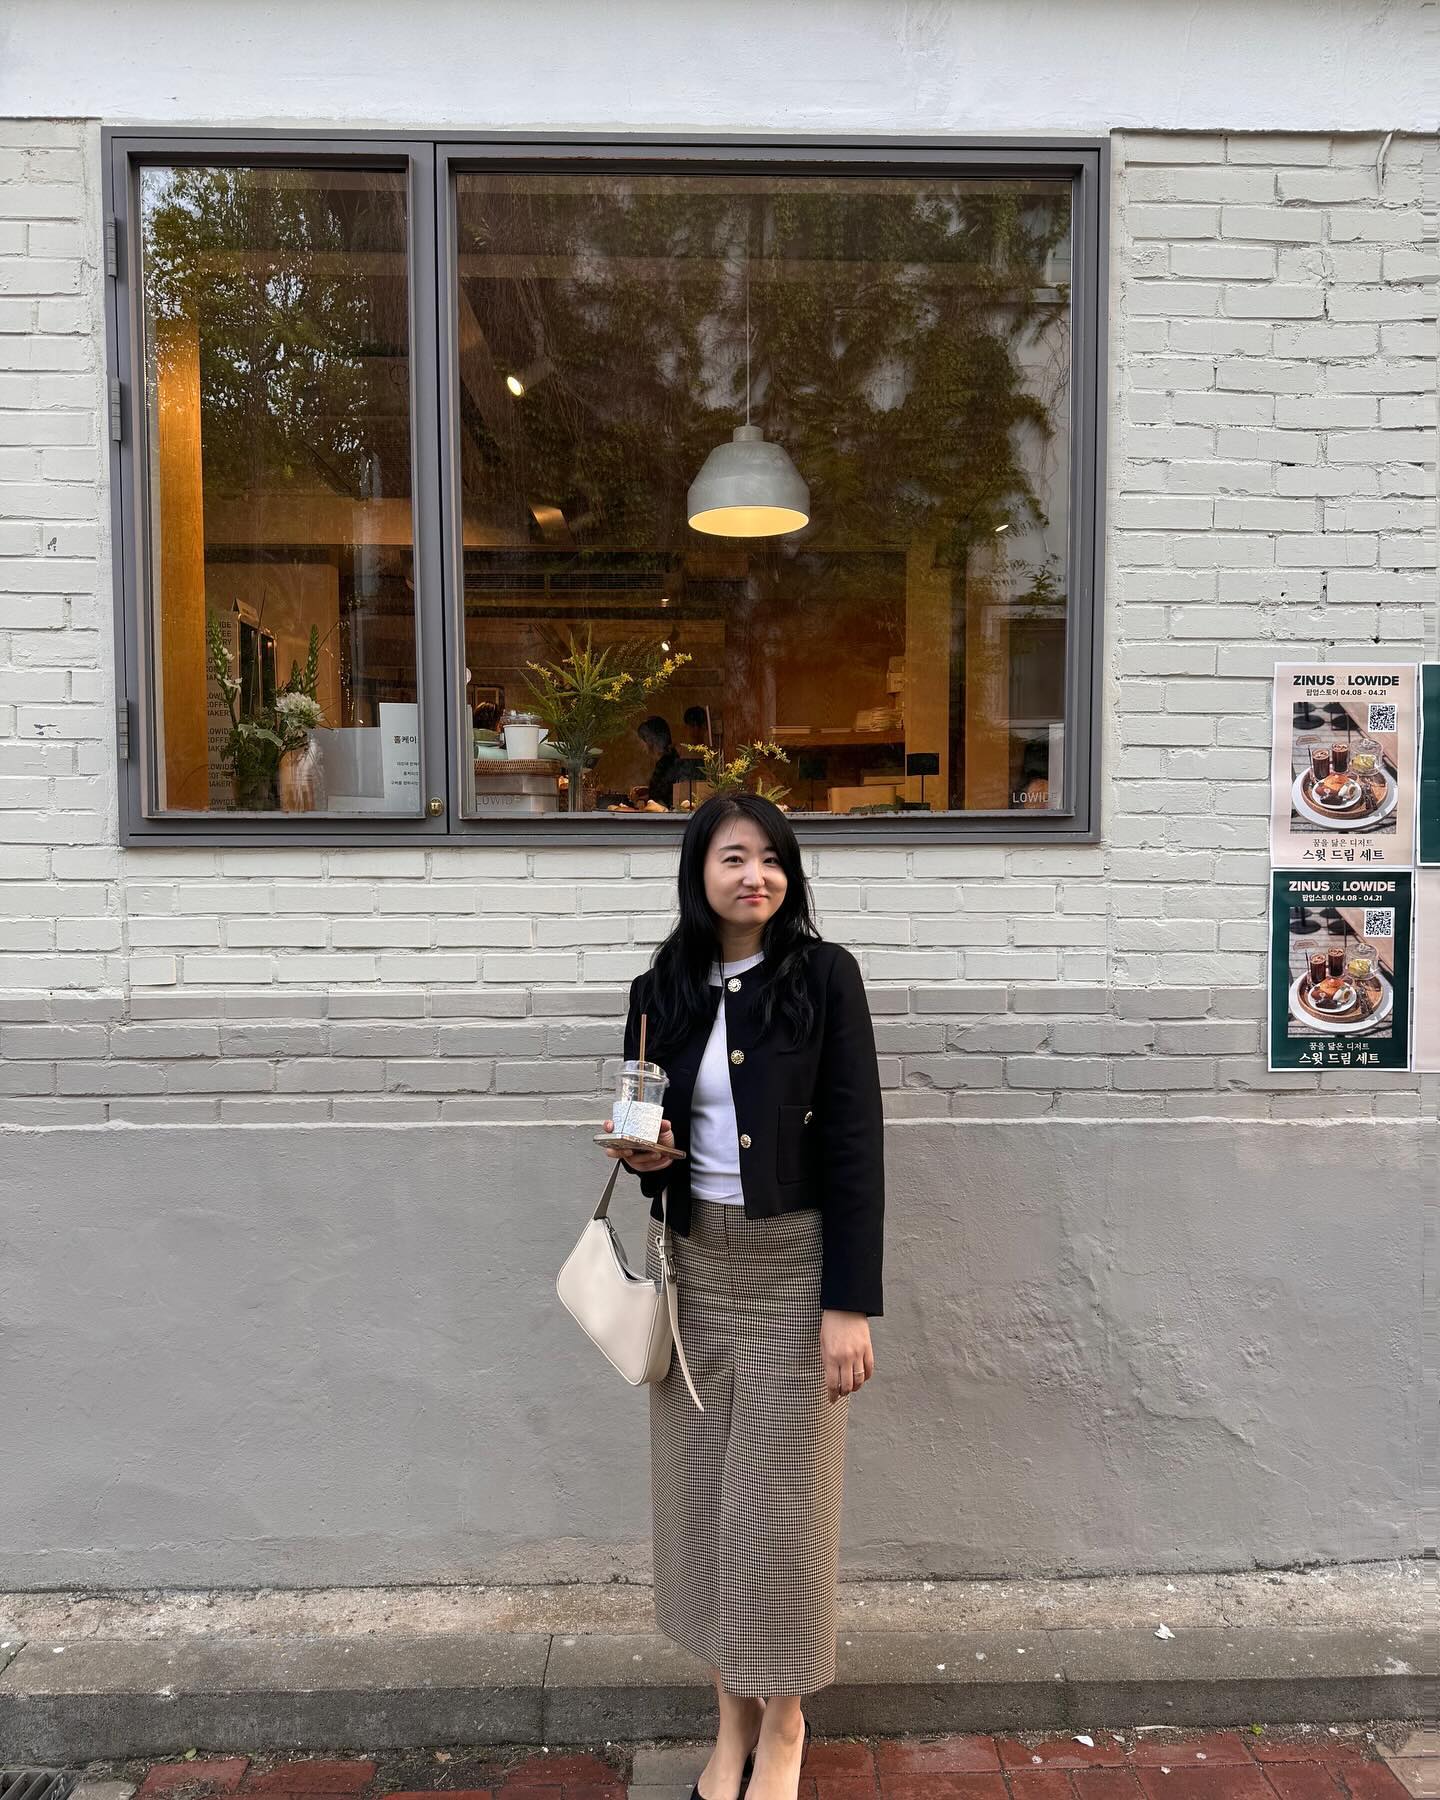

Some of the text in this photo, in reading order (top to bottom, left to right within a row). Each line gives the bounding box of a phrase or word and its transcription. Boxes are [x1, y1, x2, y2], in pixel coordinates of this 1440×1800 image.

[1293, 675, 1335, 686] ZINUS
[1347, 675, 1400, 686] LOWIDE
[1306, 688, 1339, 697] 팝업스토어
[1302, 848, 1385, 861] 스윗 드림 세트
[1288, 880, 1330, 892] ZINUS
[1342, 881, 1396, 892] LOWIDE
[1302, 894, 1334, 902] 팝업스토어
[1298, 1052, 1381, 1065] 스윗 드림 세트
